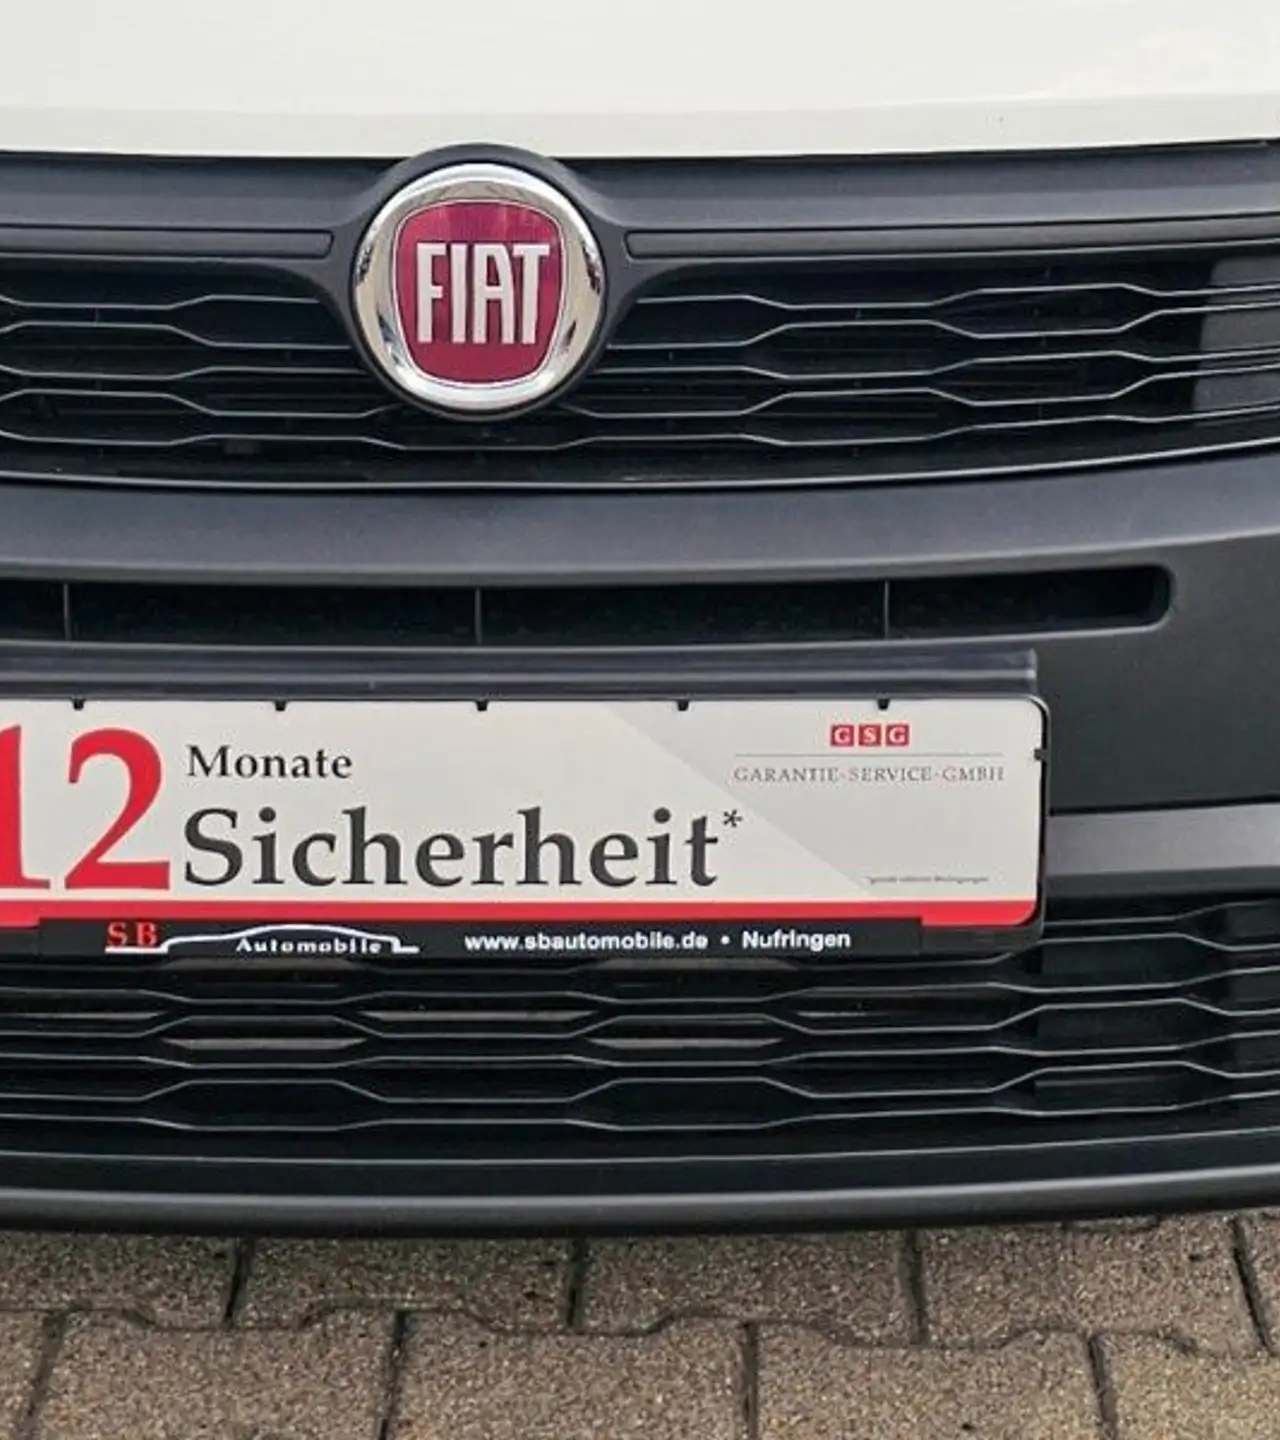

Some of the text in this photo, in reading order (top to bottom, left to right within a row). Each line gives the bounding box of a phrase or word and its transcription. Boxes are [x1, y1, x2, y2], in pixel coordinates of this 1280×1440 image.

[417, 242, 550, 345] FIAT
[832, 724, 907, 747] GSG
[186, 745, 353, 779] Monate
[235, 937, 383, 954] Automobile
[464, 931, 852, 951] www.sbautomobile.de Nufringen
